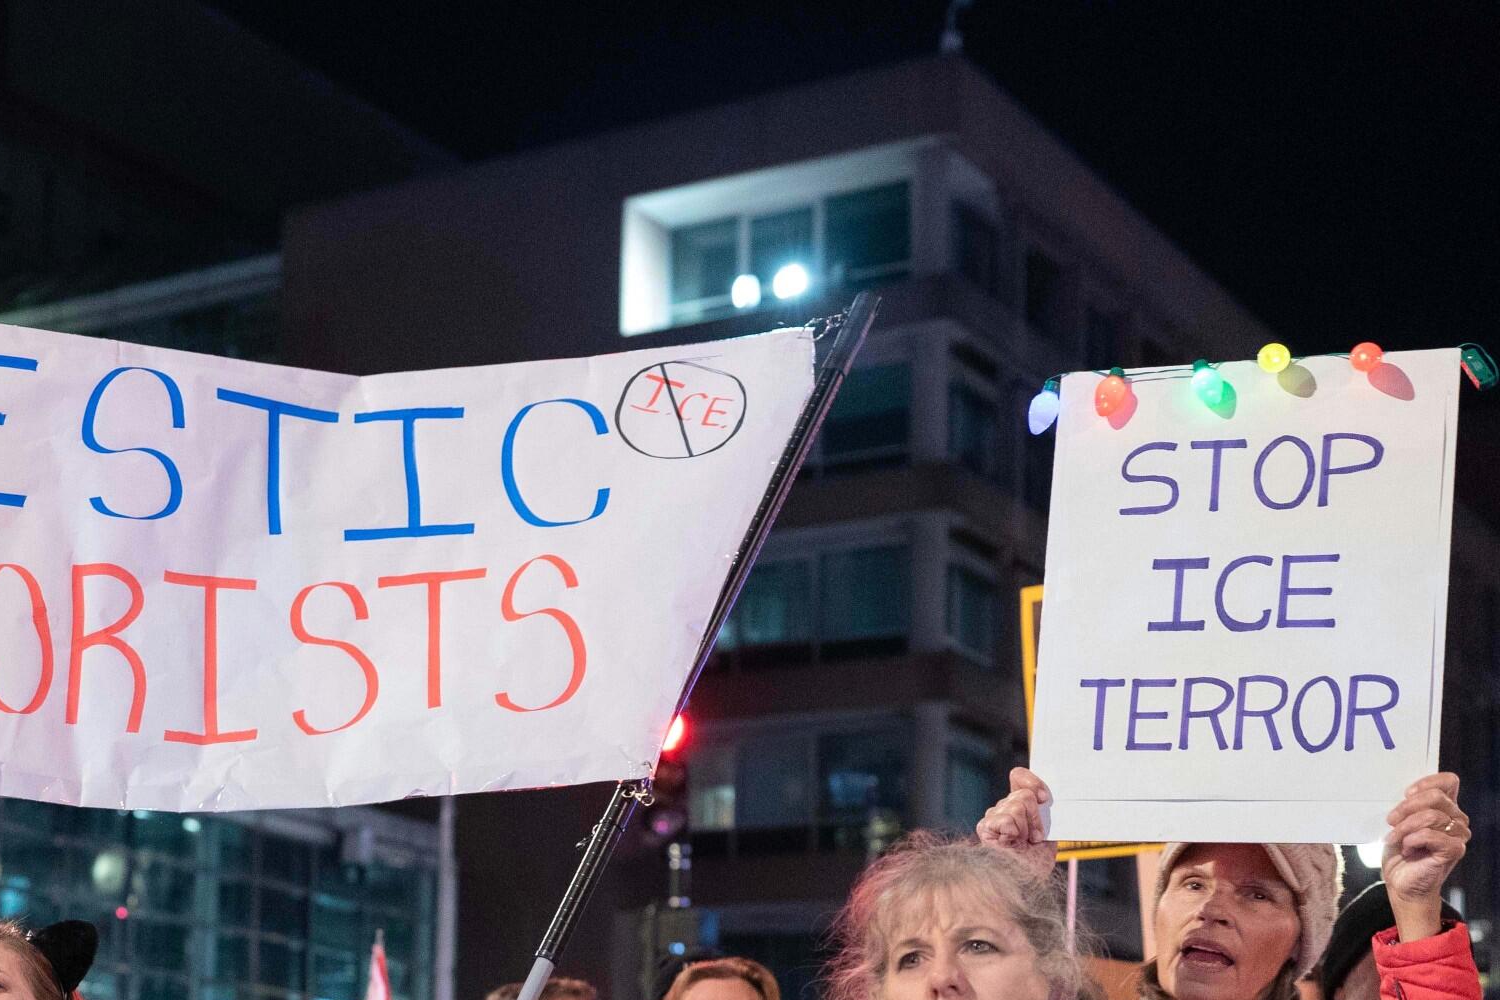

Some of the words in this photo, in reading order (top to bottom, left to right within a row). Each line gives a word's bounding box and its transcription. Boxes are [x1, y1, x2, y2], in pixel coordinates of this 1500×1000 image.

[1119, 432, 1385, 515] STOP
[1147, 553, 1340, 632] ICE
[1080, 674, 1400, 753] TERROR
